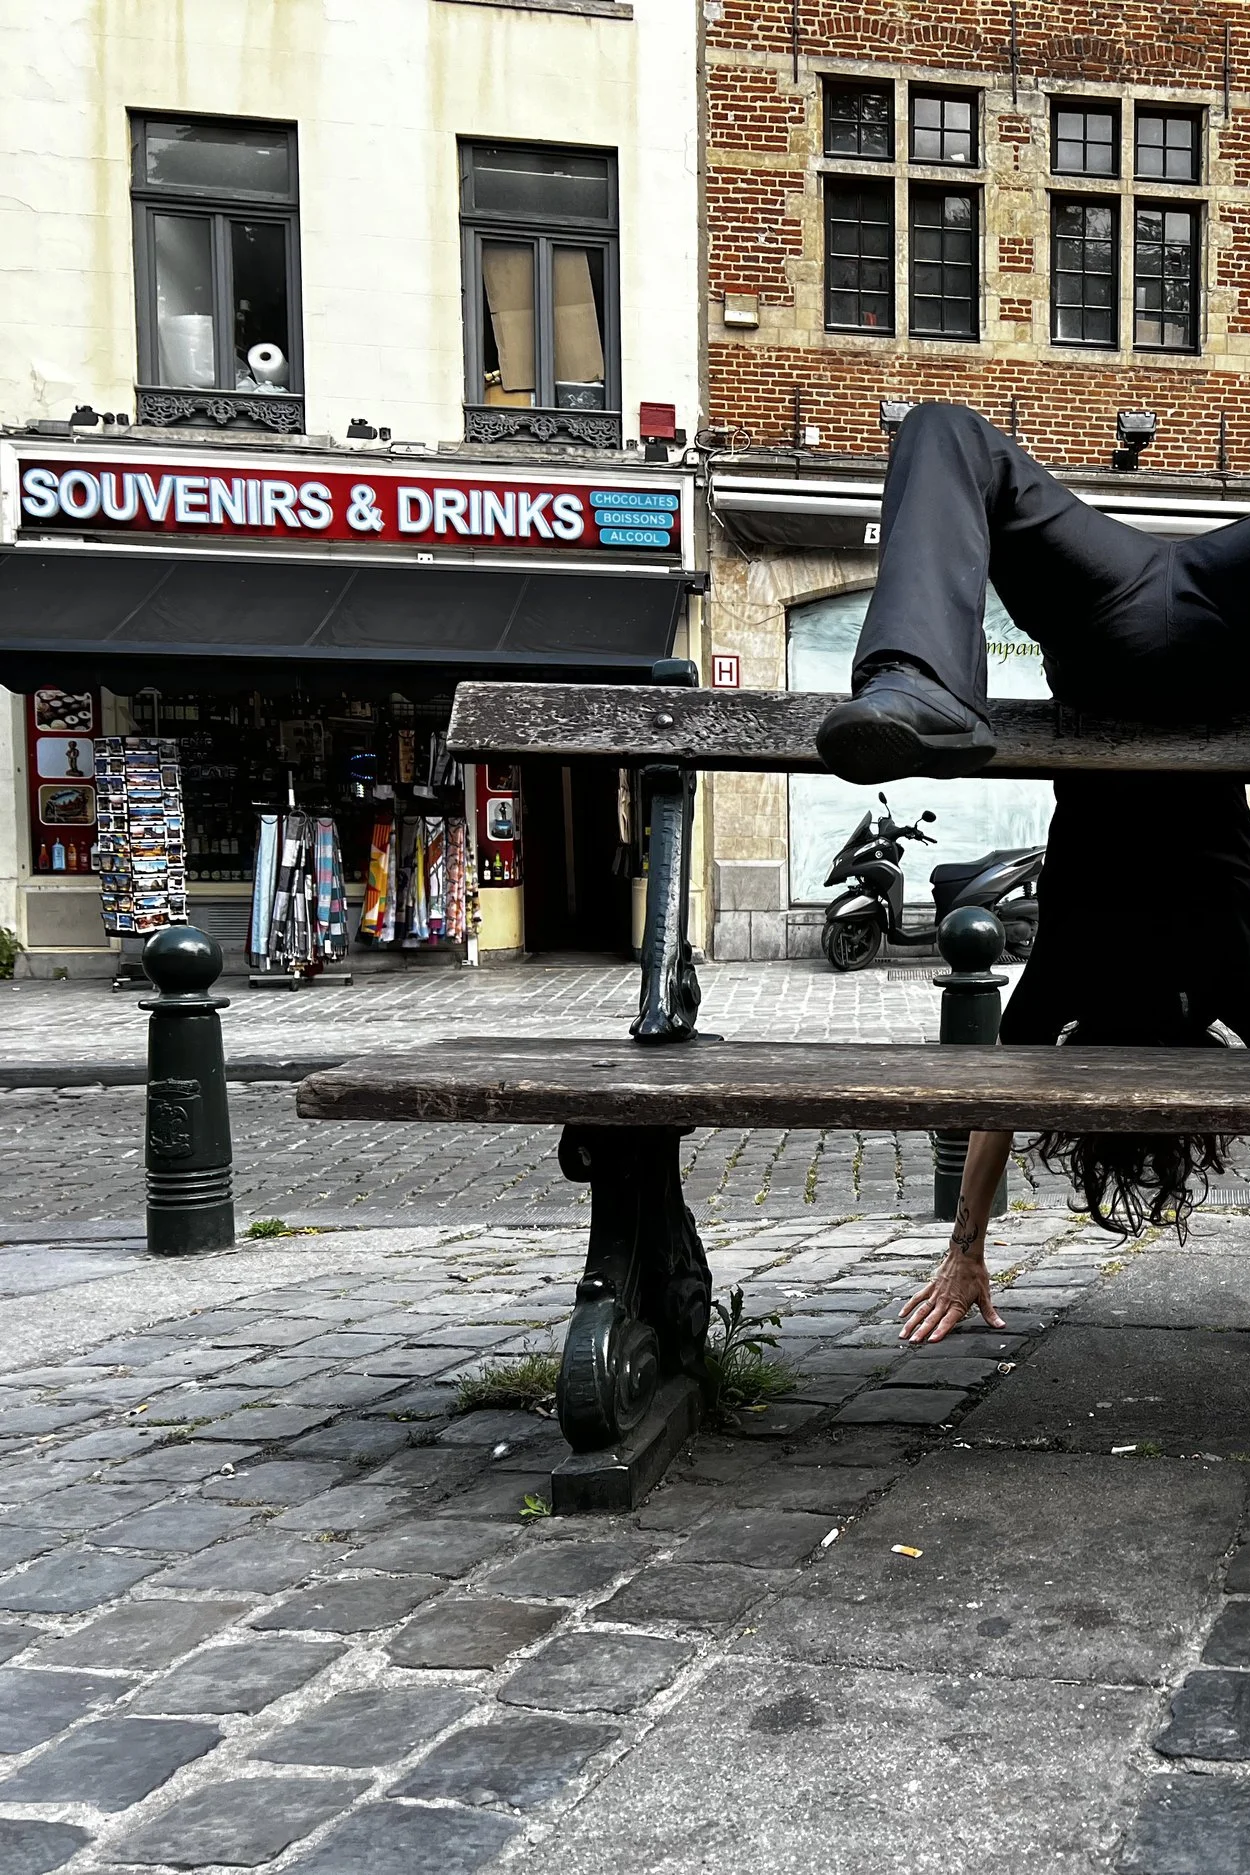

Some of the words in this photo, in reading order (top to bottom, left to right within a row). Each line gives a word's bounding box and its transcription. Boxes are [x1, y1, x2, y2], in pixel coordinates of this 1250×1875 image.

[21, 467, 332, 531] SOUVENIRS
[346, 482, 385, 533] &
[398, 485, 586, 541] DRINKS
[595, 493, 674, 508] CHOCOLATES
[603, 512, 666, 525] BOISSONS
[610, 531, 660, 543] ALCOOL
[718, 661, 734, 682] H
